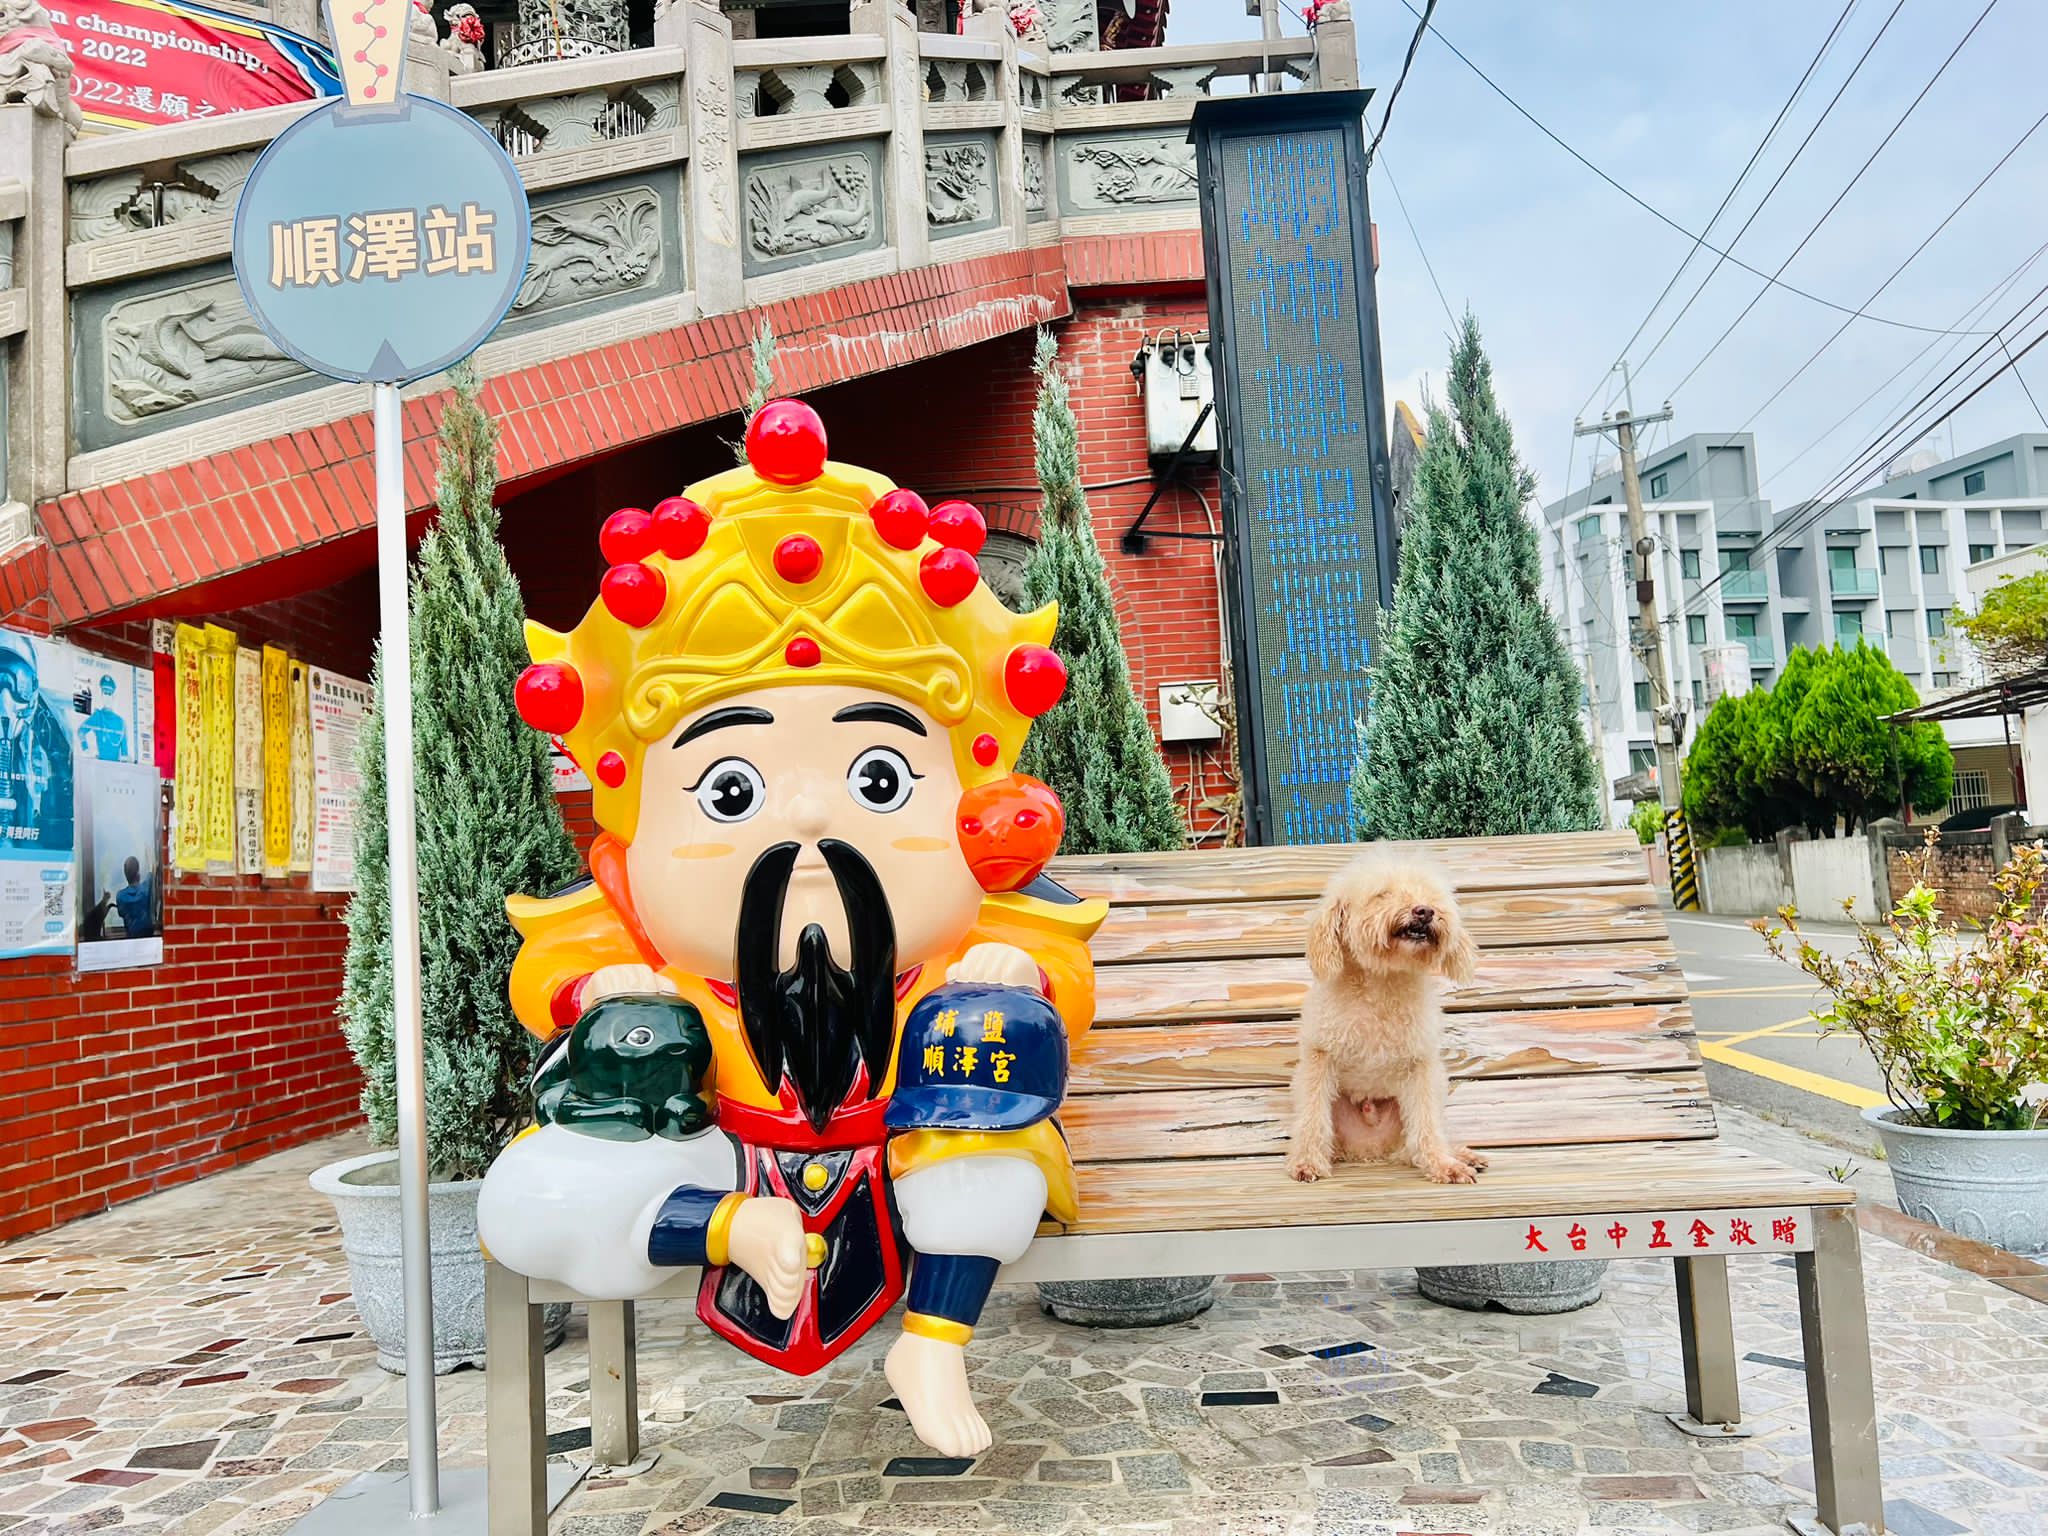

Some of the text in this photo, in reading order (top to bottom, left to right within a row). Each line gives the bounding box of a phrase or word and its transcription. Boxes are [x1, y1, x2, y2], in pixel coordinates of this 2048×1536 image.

[75, 13, 270, 73] championship,
[81, 37, 147, 67] 2022
[268, 202, 497, 289] 順澤站
[933, 1009, 1007, 1044] 埔鹽
[922, 1045, 1017, 1083] 順澤宮
[1524, 1216, 1798, 1252] 大台中五金敬贈
